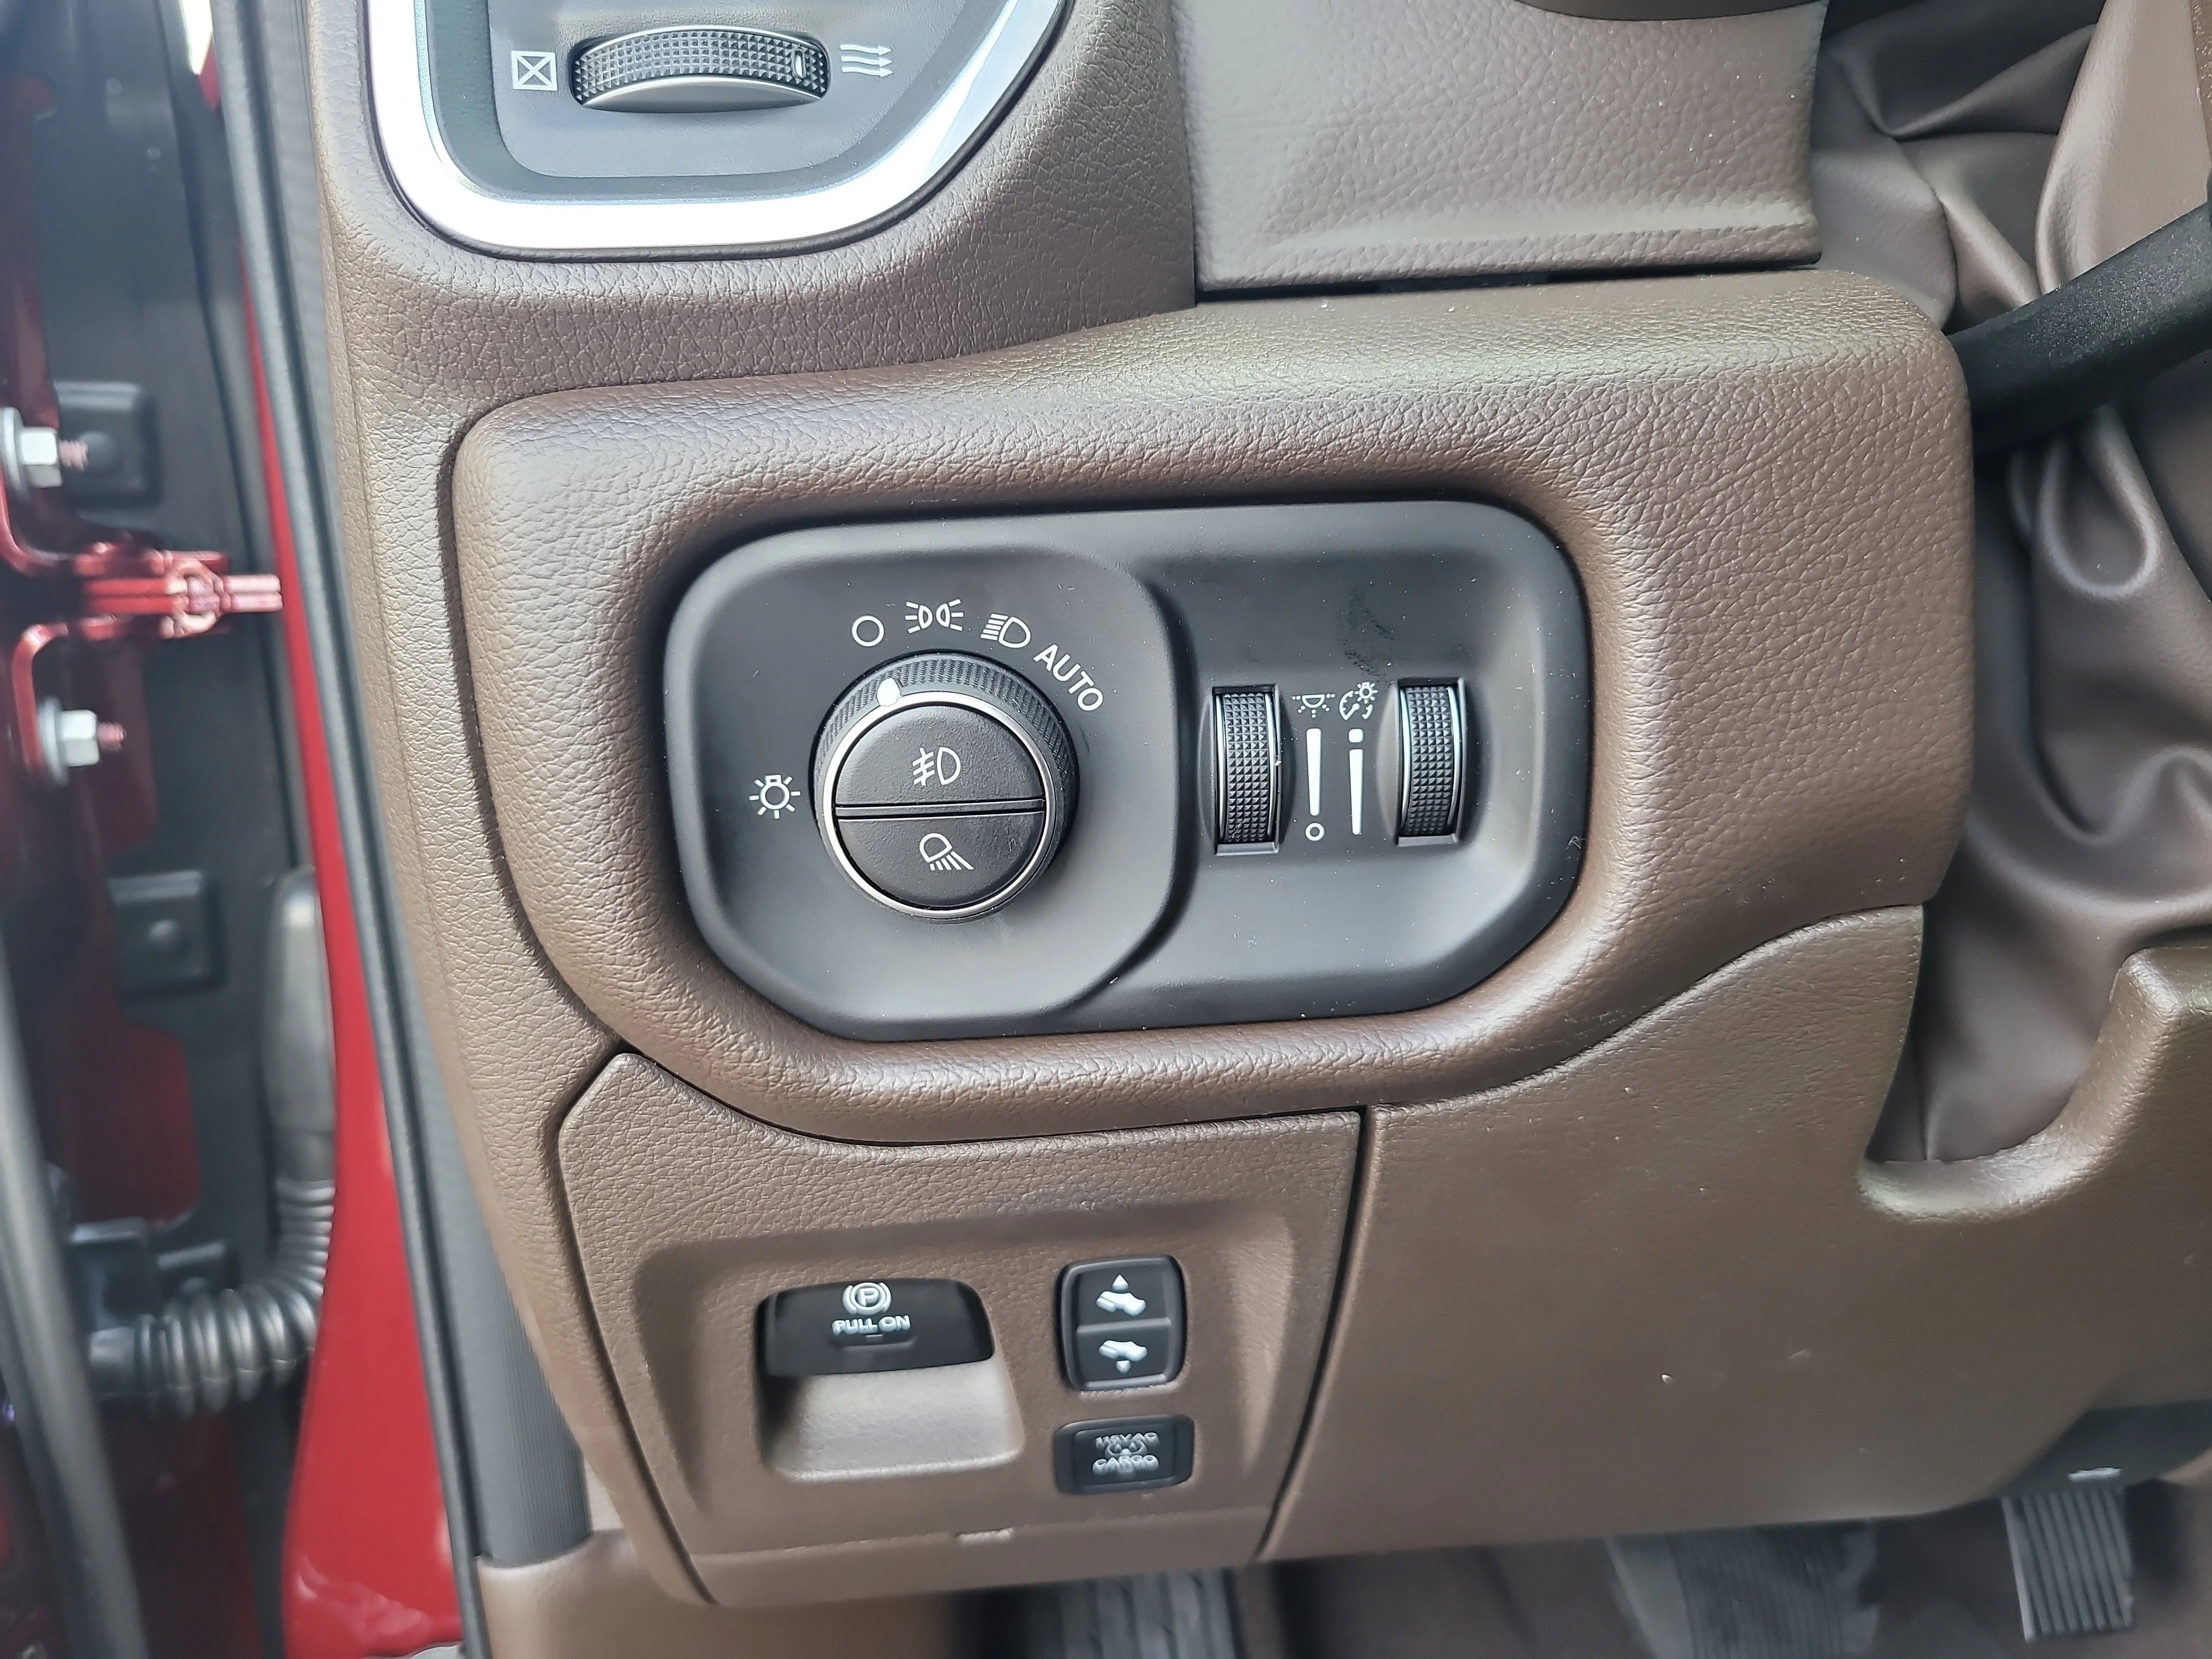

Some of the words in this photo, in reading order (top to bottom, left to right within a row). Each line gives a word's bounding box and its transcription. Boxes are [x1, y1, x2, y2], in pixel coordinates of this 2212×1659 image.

[1033, 644, 1104, 712] AUTO
[832, 1318, 878, 1335] PULL
[878, 1315, 911, 1331] ON
[1092, 1454, 1160, 1474] CARGO
